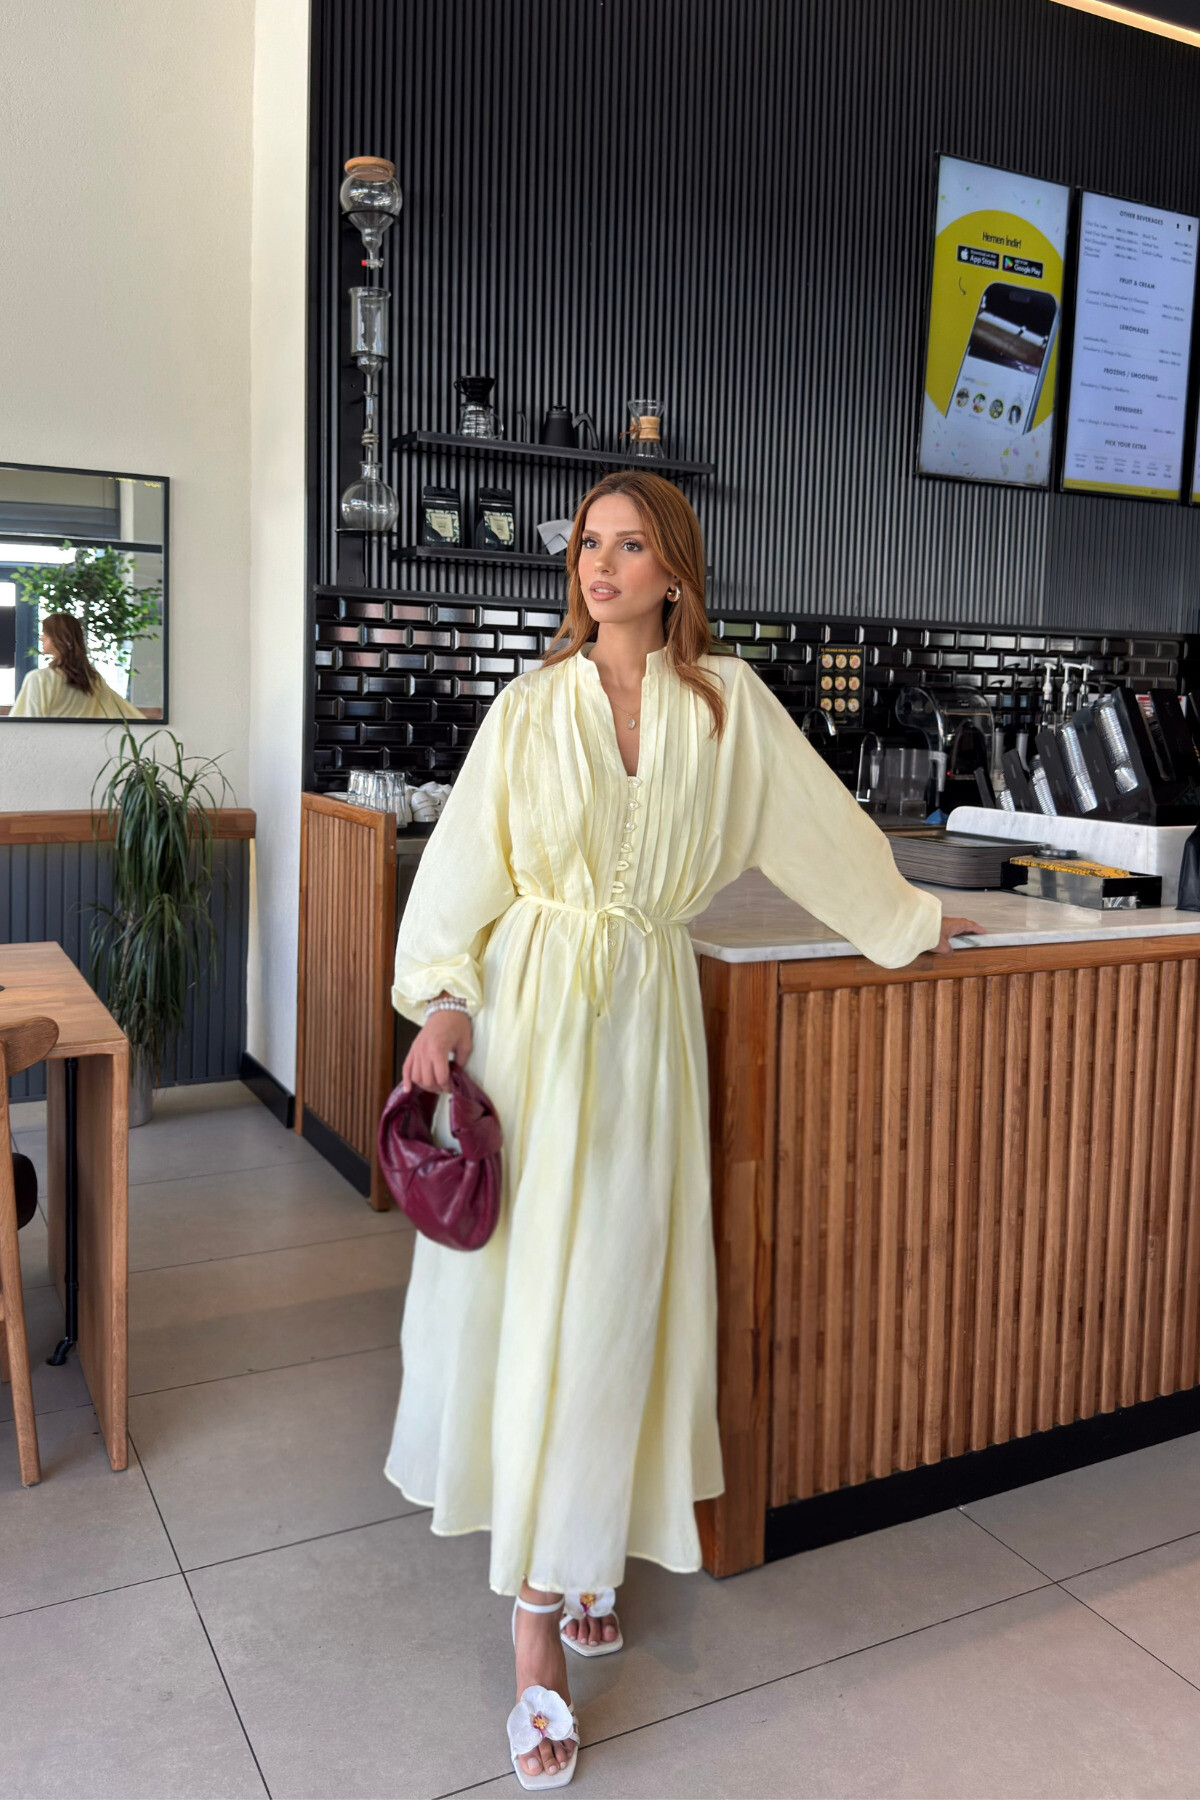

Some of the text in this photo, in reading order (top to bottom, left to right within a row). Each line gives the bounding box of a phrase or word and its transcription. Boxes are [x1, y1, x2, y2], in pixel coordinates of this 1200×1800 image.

[1120, 210, 1163, 226] OTHER BEVERAGES
[982, 232, 1004, 245] Hemen
[970, 255, 996, 267] App Store
[1014, 264, 1041, 277] Google Play
[1139, 281, 1155, 289] CREAM
[1120, 324, 1149, 335] LEMONADES
[1131, 372, 1158, 382] SMOOTHIES
[1114, 405, 1142, 415] REFRESHERS
